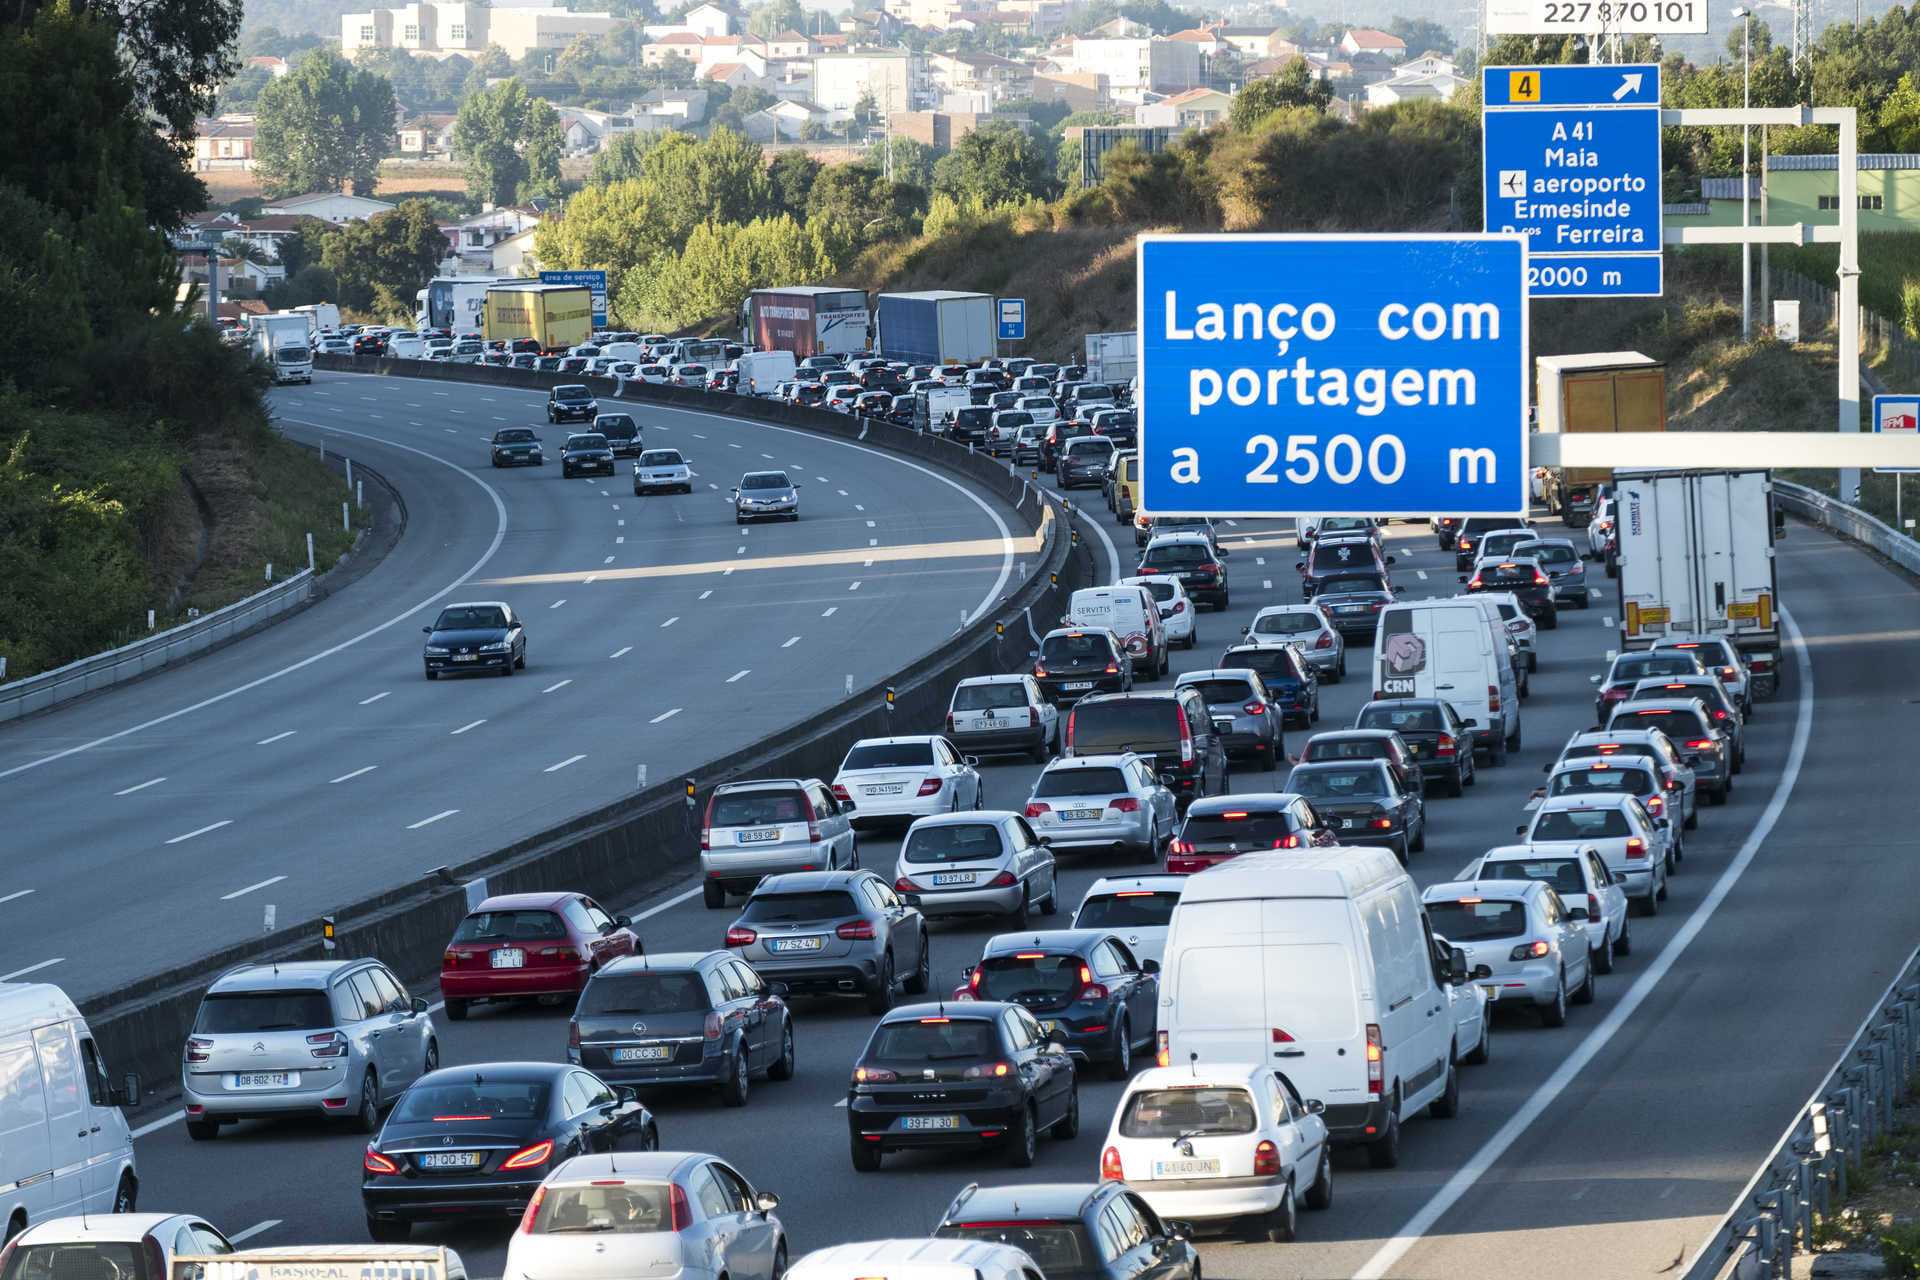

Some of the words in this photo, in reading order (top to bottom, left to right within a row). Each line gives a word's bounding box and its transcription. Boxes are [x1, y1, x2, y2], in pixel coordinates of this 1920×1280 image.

[1543, 2, 1592, 23] 227
[1597, 2, 1648, 23] 870
[1653, 2, 1693, 23] 101
[1517, 75, 1533, 98] 4
[1551, 121, 1568, 141] A
[1571, 120, 1593, 141] 41
[1544, 147, 1599, 168] Maia
[1532, 172, 1646, 197] aeroporto
[1514, 198, 1632, 220] Ermesinde
[1556, 223, 1645, 245] Ferreira
[1528, 266, 1588, 287] 2000
[1602, 270, 1622, 286] m
[1165, 290, 1337, 357] Lanço
[1377, 301, 1501, 341] com
[1189, 356, 1477, 417] portagem
[1169, 446, 1201, 485] a
[1244, 433, 1407, 485] 2500
[1448, 446, 1498, 485] m
[1076, 606, 1112, 615] SERVITIS
[1383, 679, 1415, 694] CRN
